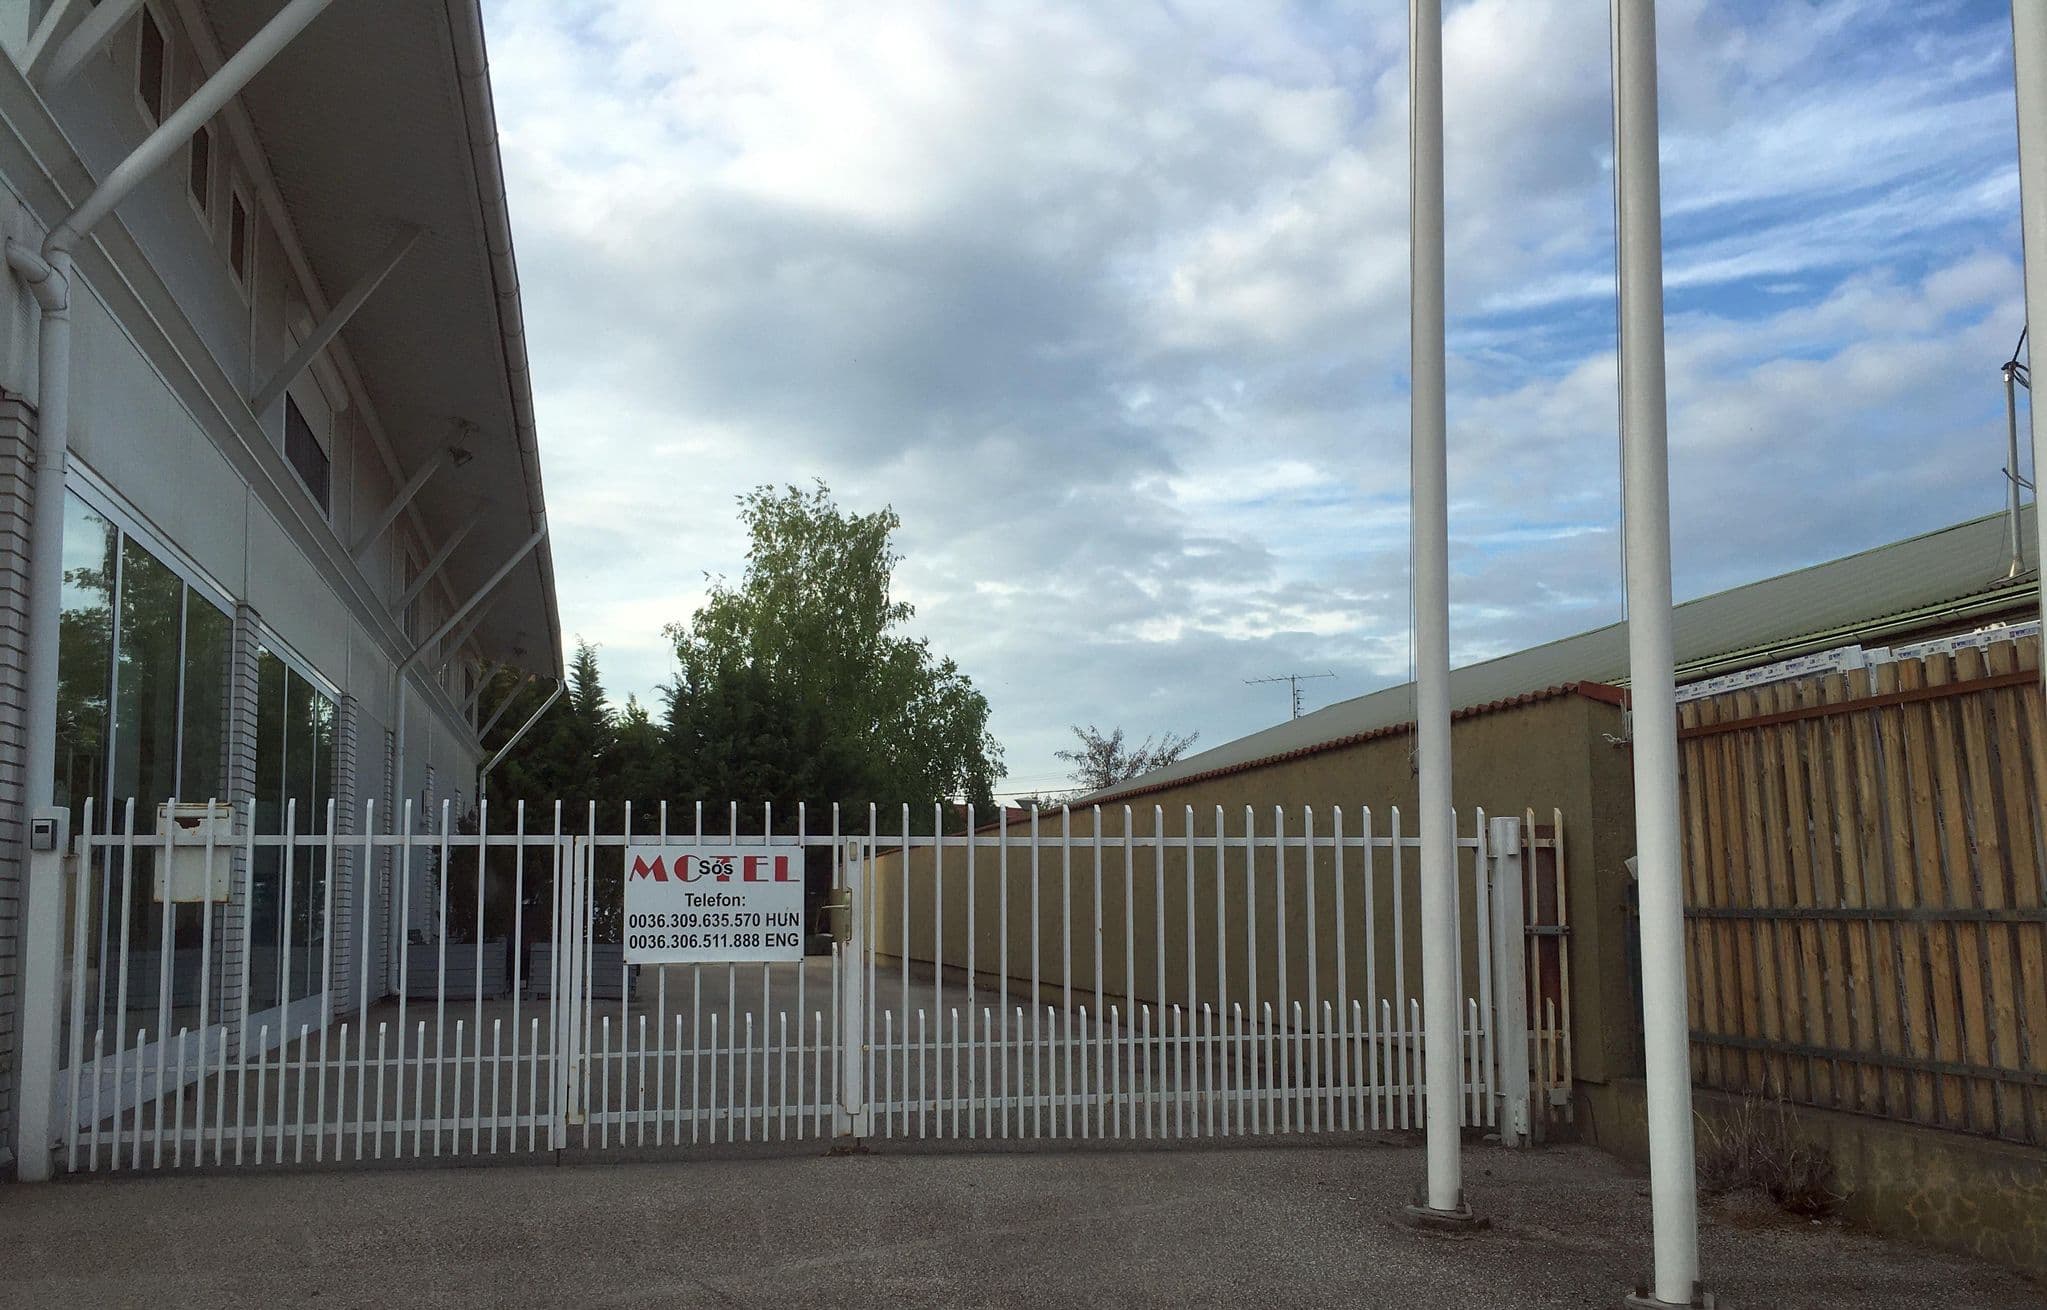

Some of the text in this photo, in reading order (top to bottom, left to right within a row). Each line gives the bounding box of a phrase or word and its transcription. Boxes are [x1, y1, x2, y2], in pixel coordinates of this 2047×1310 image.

[629, 854, 801, 883] MOTEL
[699, 858, 734, 876] Sós
[684, 893, 746, 907] Telefon:
[629, 912, 800, 928] 0036.309.635.570 HUN
[629, 932, 799, 949] 0036.306.511.888 ENG
